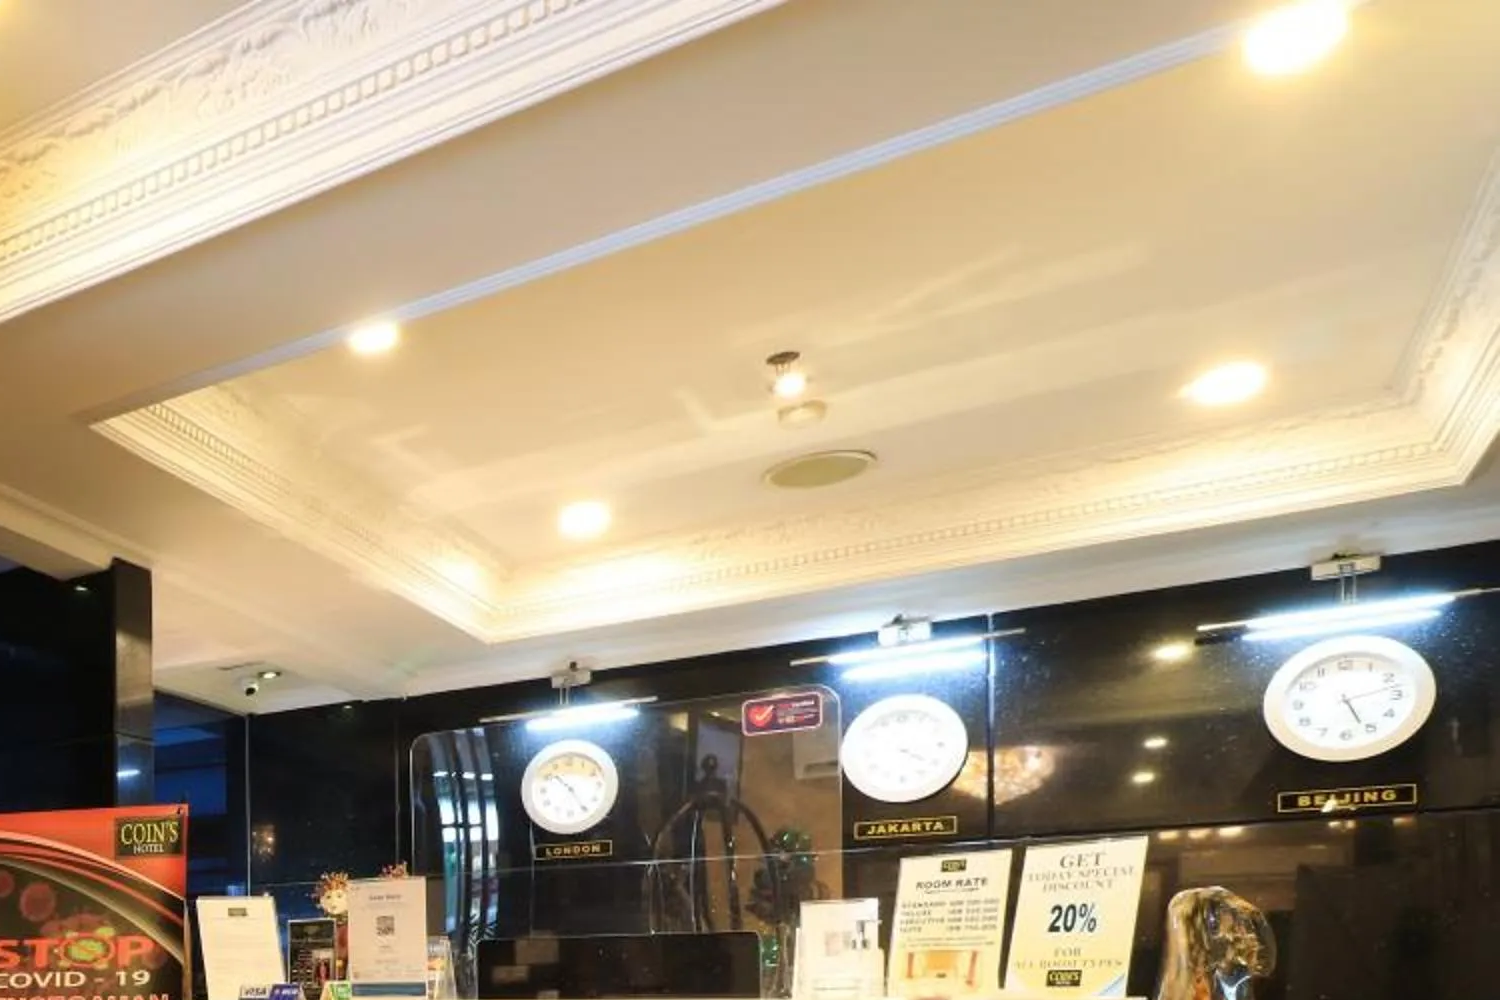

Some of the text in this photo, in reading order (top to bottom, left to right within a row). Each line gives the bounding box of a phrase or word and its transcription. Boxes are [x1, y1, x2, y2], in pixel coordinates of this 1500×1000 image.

[1298, 789, 1397, 807] BEIJING
[120, 821, 179, 845] COIN'S
[867, 821, 945, 835] JAKARTA
[132, 843, 165, 855] HOTEL
[545, 845, 601, 857] LONDON
[1060, 851, 1108, 868] GET
[916, 877, 988, 890] ROOM RATE
[1047, 903, 1098, 933] 20%
[116, 969, 151, 987] 19
